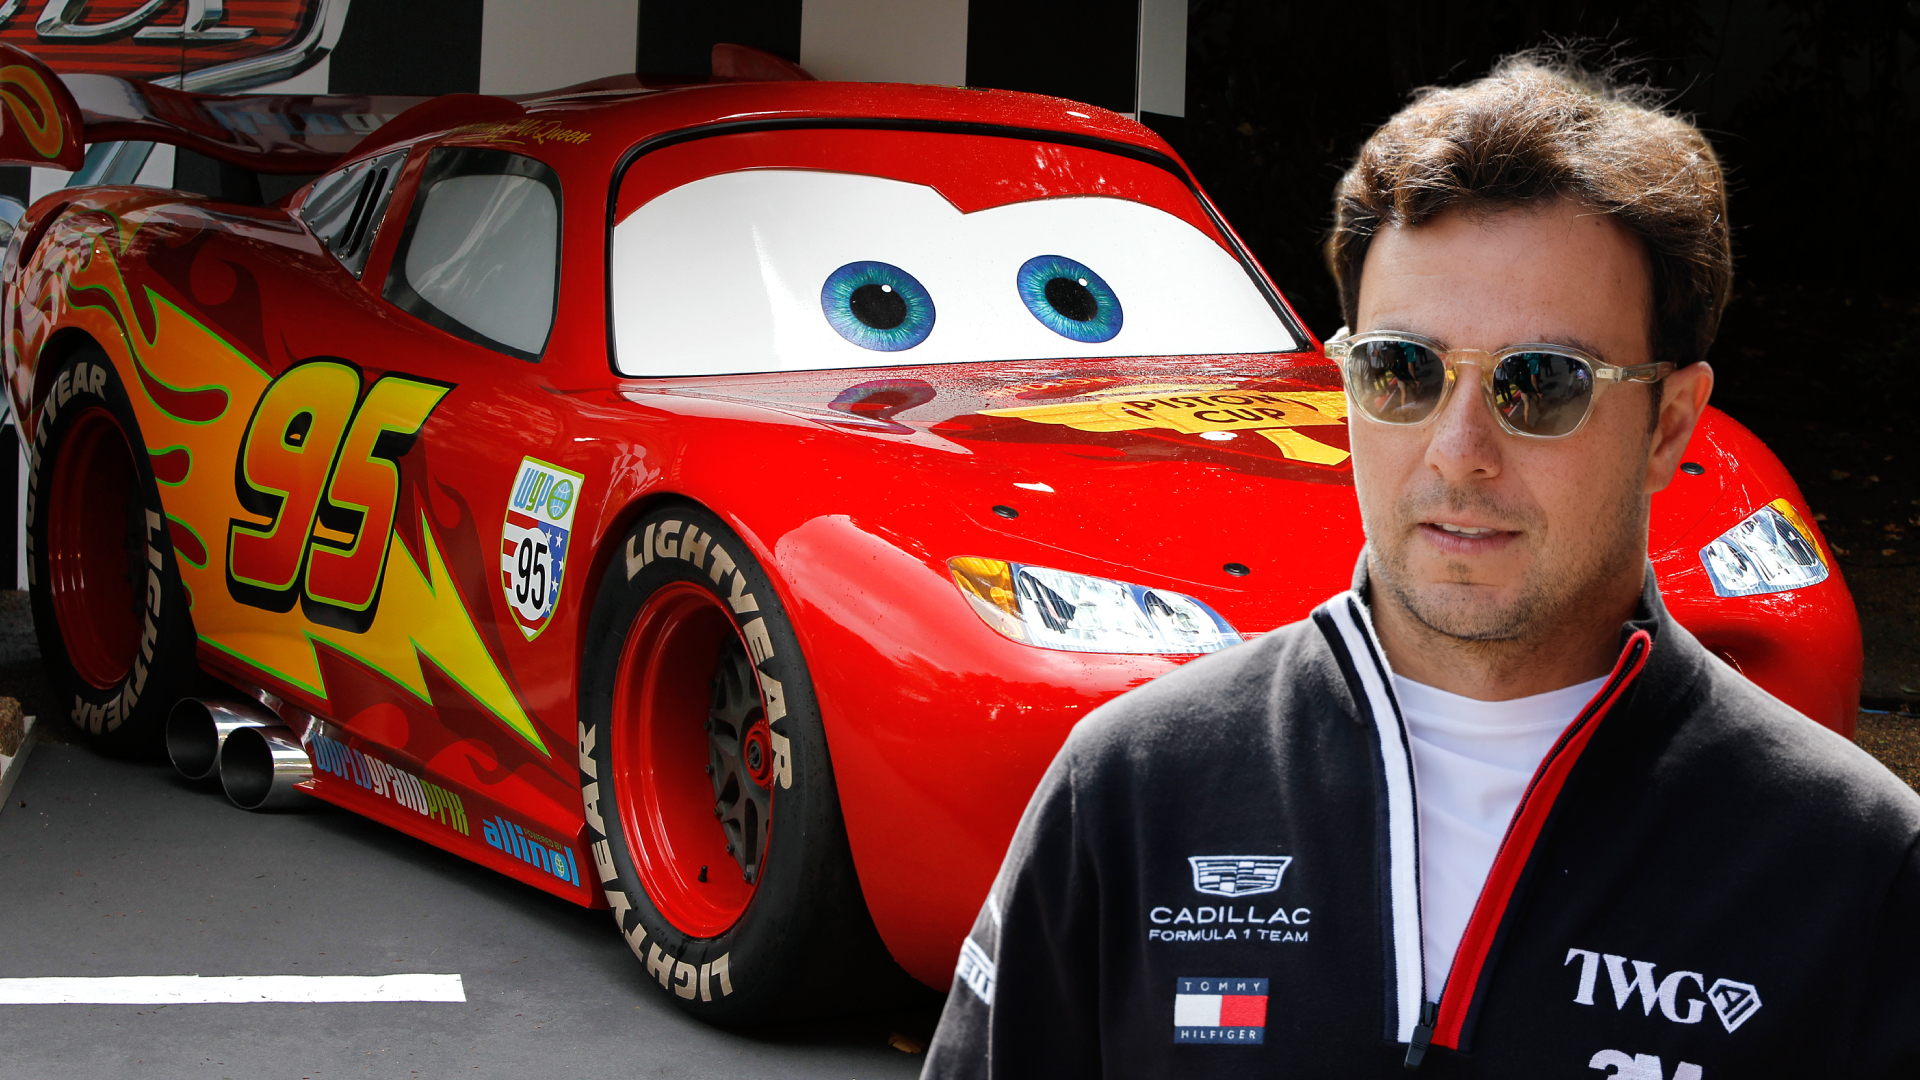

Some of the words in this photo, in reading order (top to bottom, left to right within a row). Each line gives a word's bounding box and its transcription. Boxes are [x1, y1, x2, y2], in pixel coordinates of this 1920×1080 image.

[1126, 393, 1289, 412] PISTON
[1192, 407, 1286, 424] CUP
[225, 355, 460, 635] 95
[516, 537, 548, 610] 95
[72, 508, 163, 735] LIGHTYEAR
[625, 518, 793, 790] LIGHTYEAR
[578, 720, 733, 1002] LIGHTYEAR
[1148, 929, 1238, 942] FORMULA
[1243, 929, 1251, 940] 1
[1257, 929, 1309, 943] TEAM
[1149, 906, 1312, 925] CADILLAC
[1184, 981, 1261, 992] TOMMY
[1563, 947, 1707, 1025] TWG
[1180, 1029, 1257, 1040] HILFIGER
